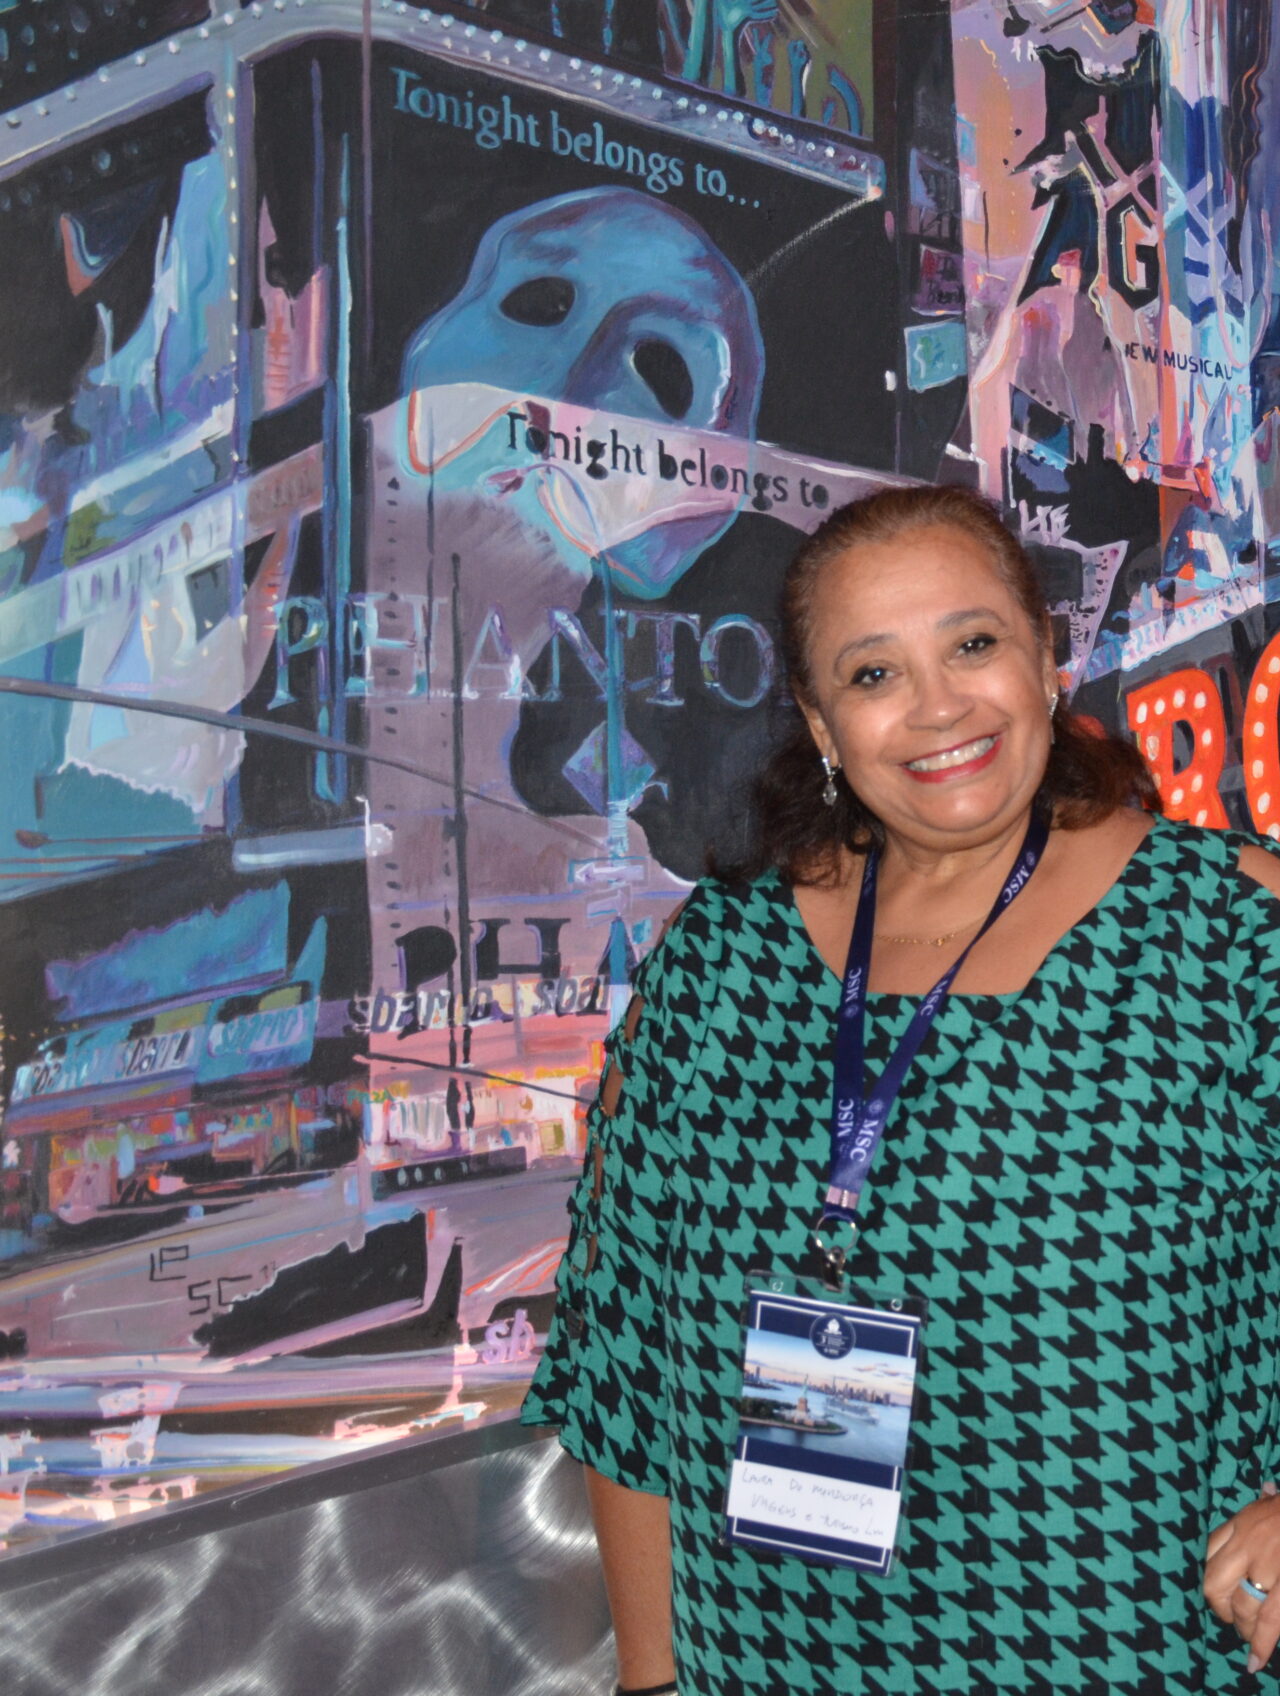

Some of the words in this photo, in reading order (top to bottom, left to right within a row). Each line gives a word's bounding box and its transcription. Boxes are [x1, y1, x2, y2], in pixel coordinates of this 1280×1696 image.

[390, 68, 540, 149] Tonight
[550, 111, 684, 193] belongs
[1163, 350, 1233, 381] MUSICAL
[507, 411, 645, 480] Tonight
[658, 440, 788, 511] belongs
[1002, 863, 1030, 904] MSC
[845, 967, 862, 1004] MSC
[920, 980, 948, 1017] MSC
[837, 1098, 855, 1139] MSC
[850, 1119, 880, 1163] MSC
